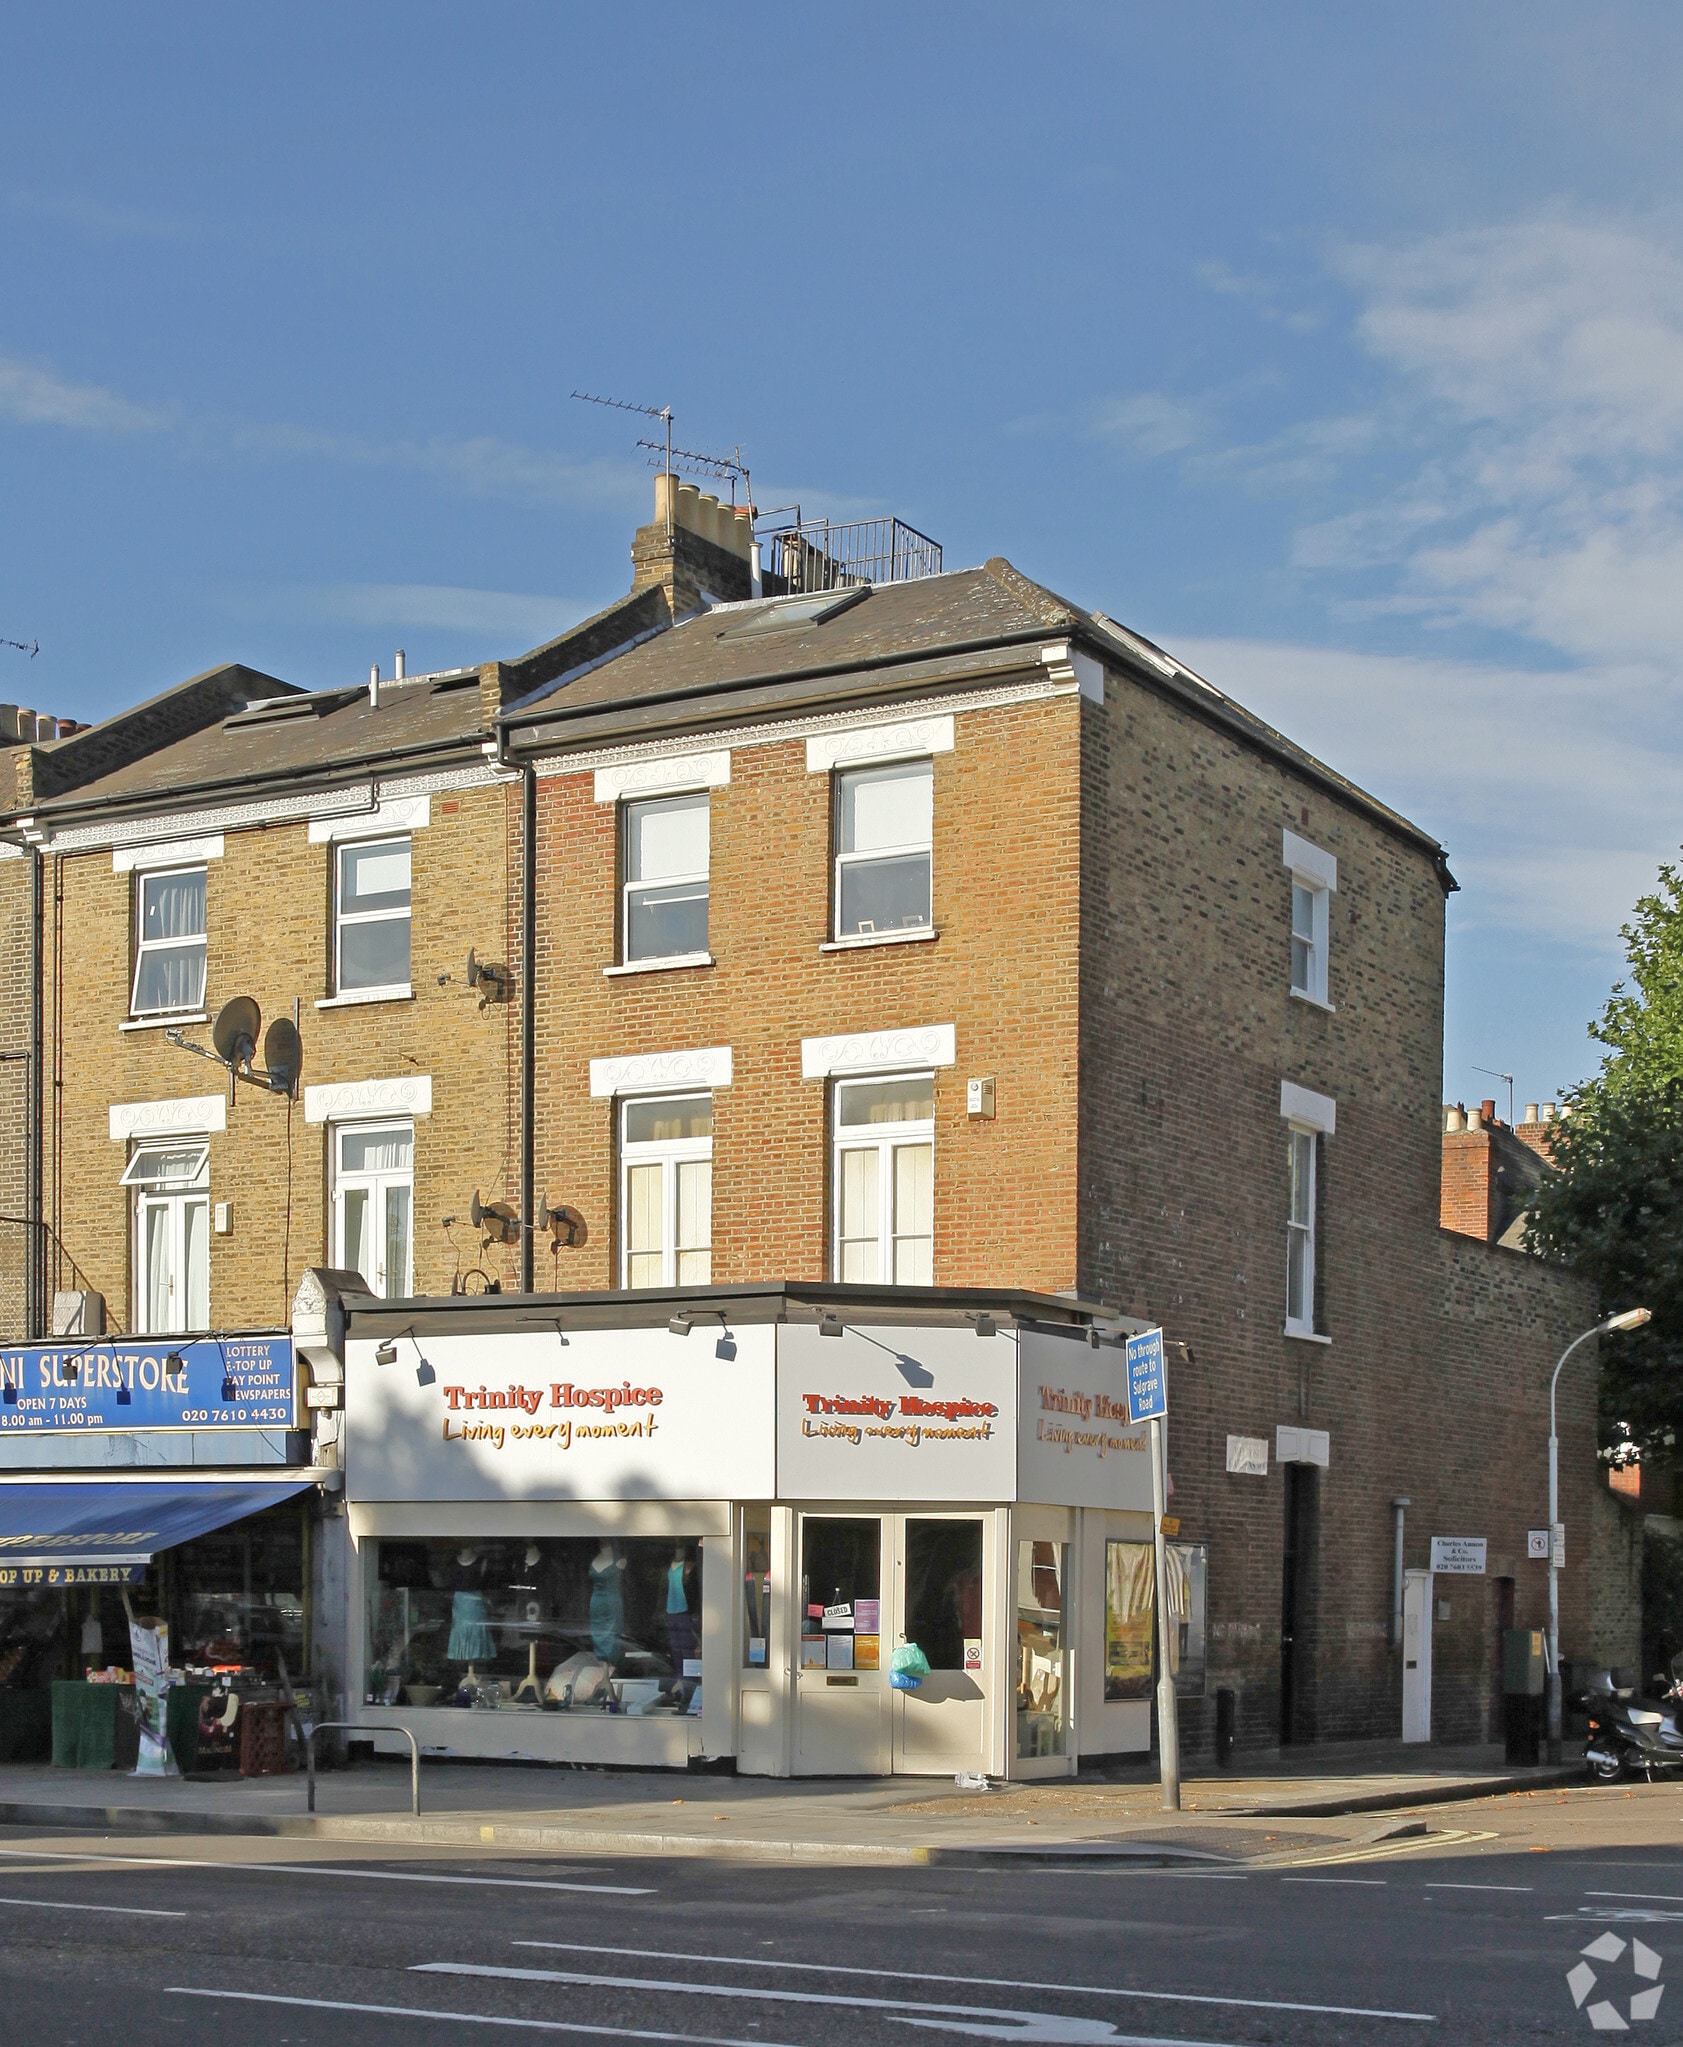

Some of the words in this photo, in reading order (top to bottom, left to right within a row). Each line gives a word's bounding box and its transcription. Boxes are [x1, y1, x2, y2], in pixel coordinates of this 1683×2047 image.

[226, 1345, 270, 1358] LOTTERY
[1128, 1346, 1137, 1361] No
[1138, 1339, 1160, 1358] through
[39, 1353, 190, 1395] SUPERSTORE
[226, 1360, 256, 1372] E-TOP
[258, 1359, 273, 1371] UP
[1133, 1361, 1148, 1377] route
[1149, 1358, 1157, 1373] to
[226, 1374, 246, 1387] PAY
[248, 1373, 281, 1386] POINT
[1133, 1378, 1158, 1395] Sulgrave
[16, 1397, 46, 1410] OPEN
[49, 1396, 56, 1410] 7
[59, 1396, 87, 1409] DAYS
[226, 1388, 291, 1401] NEWSPAPERS
[443, 1384, 544, 1415] Trinity
[550, 1381, 663, 1413] Hospice
[1037, 1384, 1092, 1421] Trinity
[1138, 1394, 1153, 1411] Road
[182, 1409, 208, 1421] 020
[211, 1409, 247, 1421] 7610
[250, 1407, 287, 1420] 4430
[802, 1394, 897, 1421] Trinity
[898, 1395, 999, 1422] Hospice
[1, 1414, 26, 1427] 8.00
[28, 1416, 43, 1426] am
[54, 1412, 84, 1425] 11.00
[87, 1414, 104, 1427] pm
[442, 1417, 506, 1449] Living
[510, 1420, 572, 1450] every
[575, 1413, 659, 1438] moment
[802, 1418, 862, 1446] Living
[865, 1423, 921, 1447] every
[921, 1420, 994, 1441] moment
[1037, 1418, 1075, 1454] Living
[1076, 1430, 1108, 1459] every
[1108, 1430, 1148, 1452] moment
[22, 1569, 43, 1583] UP
[48, 1568, 59, 1583] &
[64, 1567, 132, 1583] BAKERY
[827, 1606, 848, 1616] CLOSED
